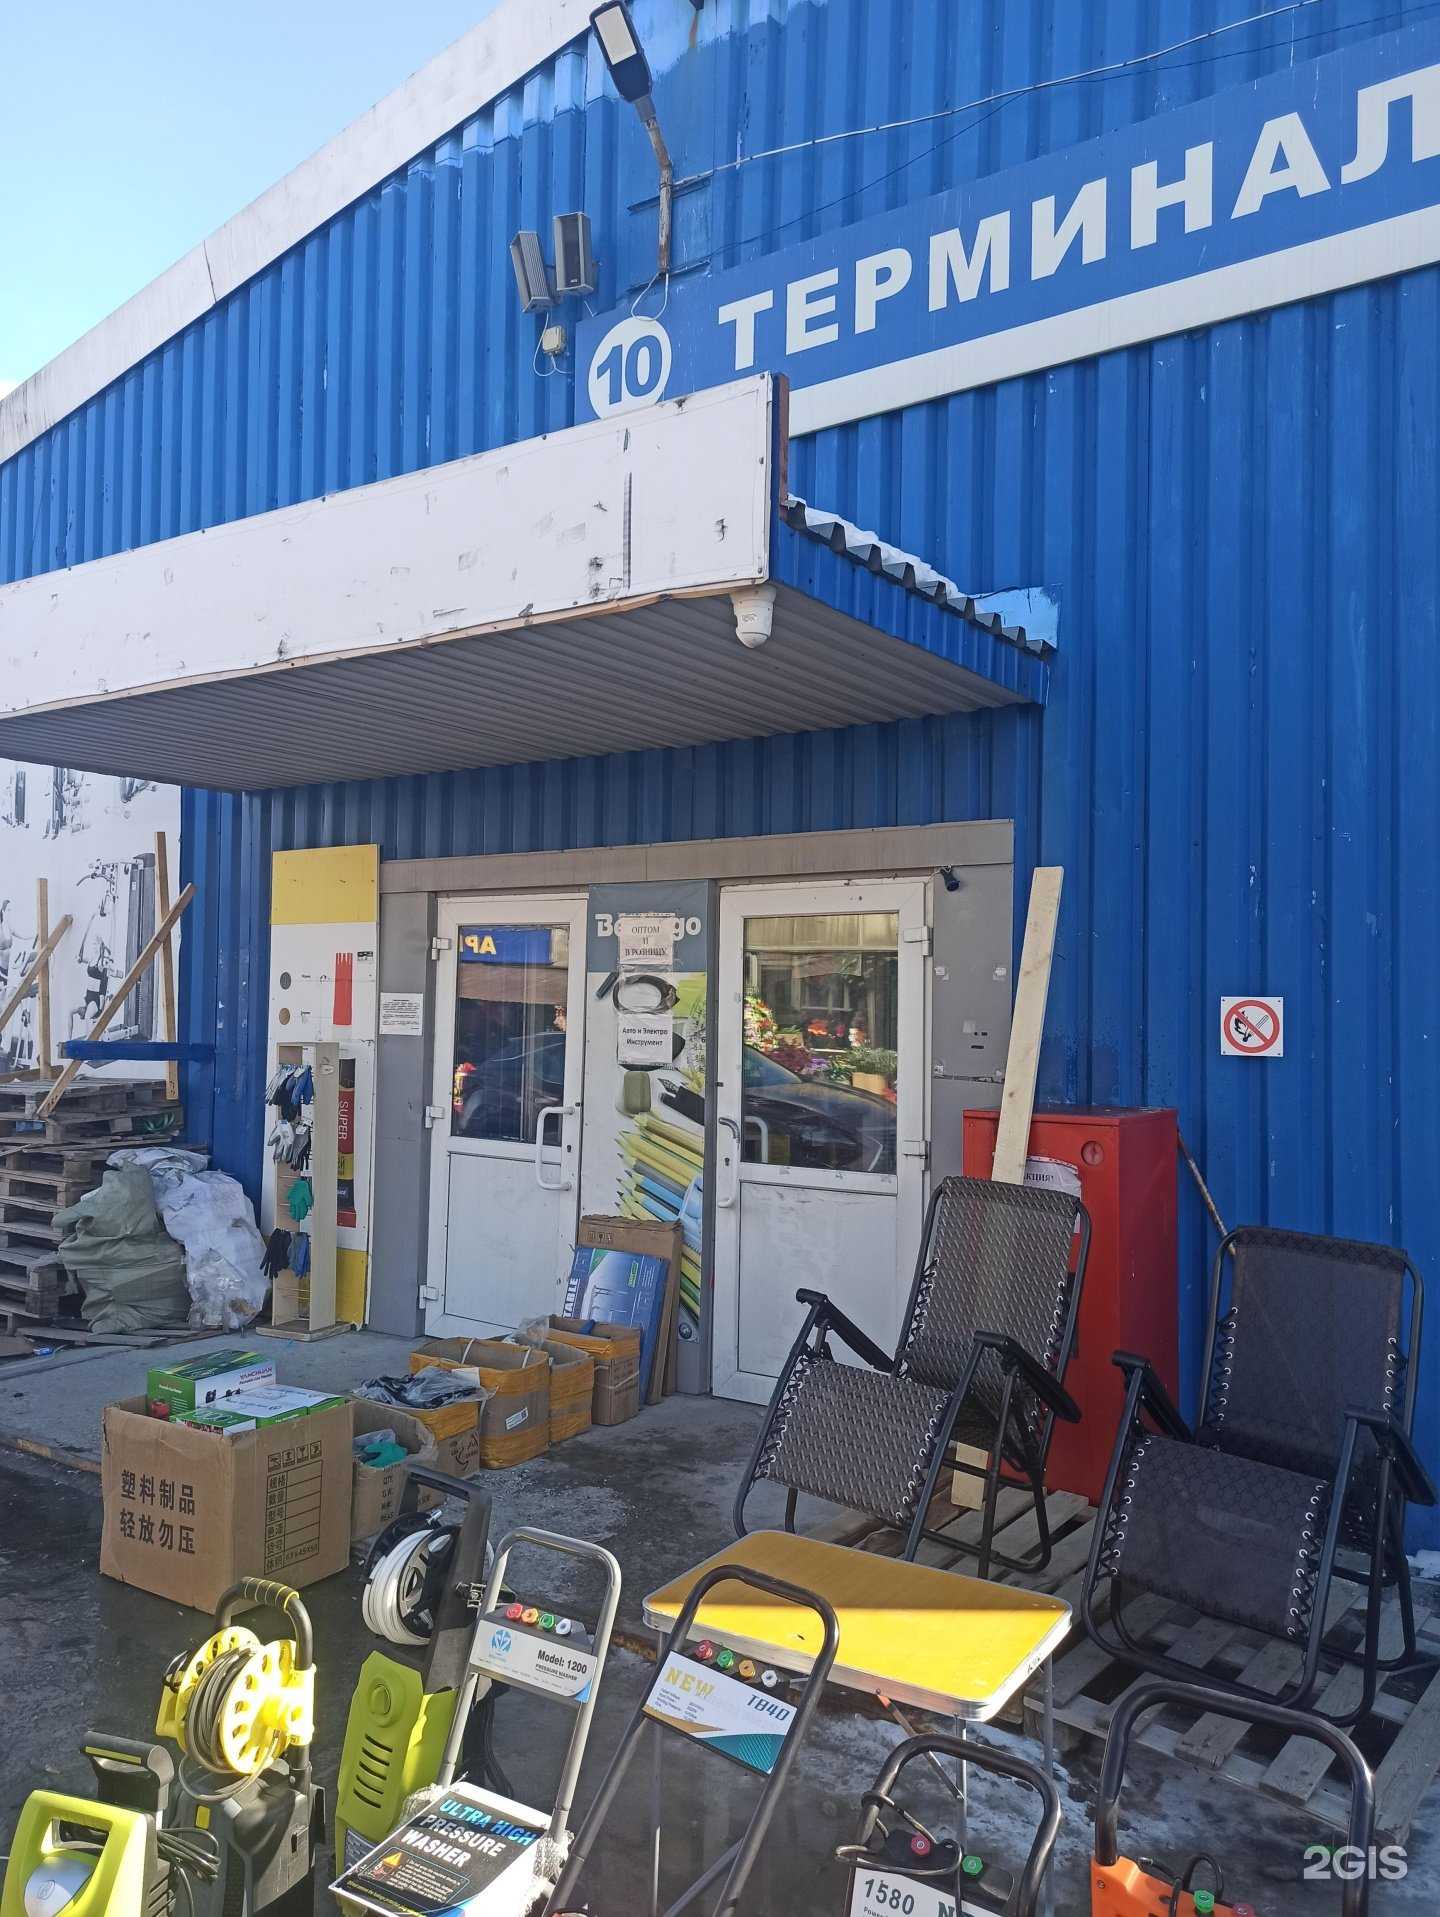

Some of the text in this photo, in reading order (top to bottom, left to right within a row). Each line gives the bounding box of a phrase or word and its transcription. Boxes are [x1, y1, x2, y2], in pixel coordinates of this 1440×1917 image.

[596, 64, 1440, 406] 10 ТЕРМИНАЛ
[631, 926, 660, 934] ОПТОМ
[338, 1100, 349, 1140] SUPER
[121, 1468, 195, 1516] 塑料制品
[120, 1507, 196, 1555] 轻放勿压
[537, 1649, 588, 1675] Model: 1200
[665, 1667, 716, 1698] NEW
[419, 1814, 507, 1857] PRESSURE
[439, 1799, 537, 1847] ULTRA HIGH
[401, 1829, 471, 1869] WASHER
[864, 1878, 915, 1915] 1580
